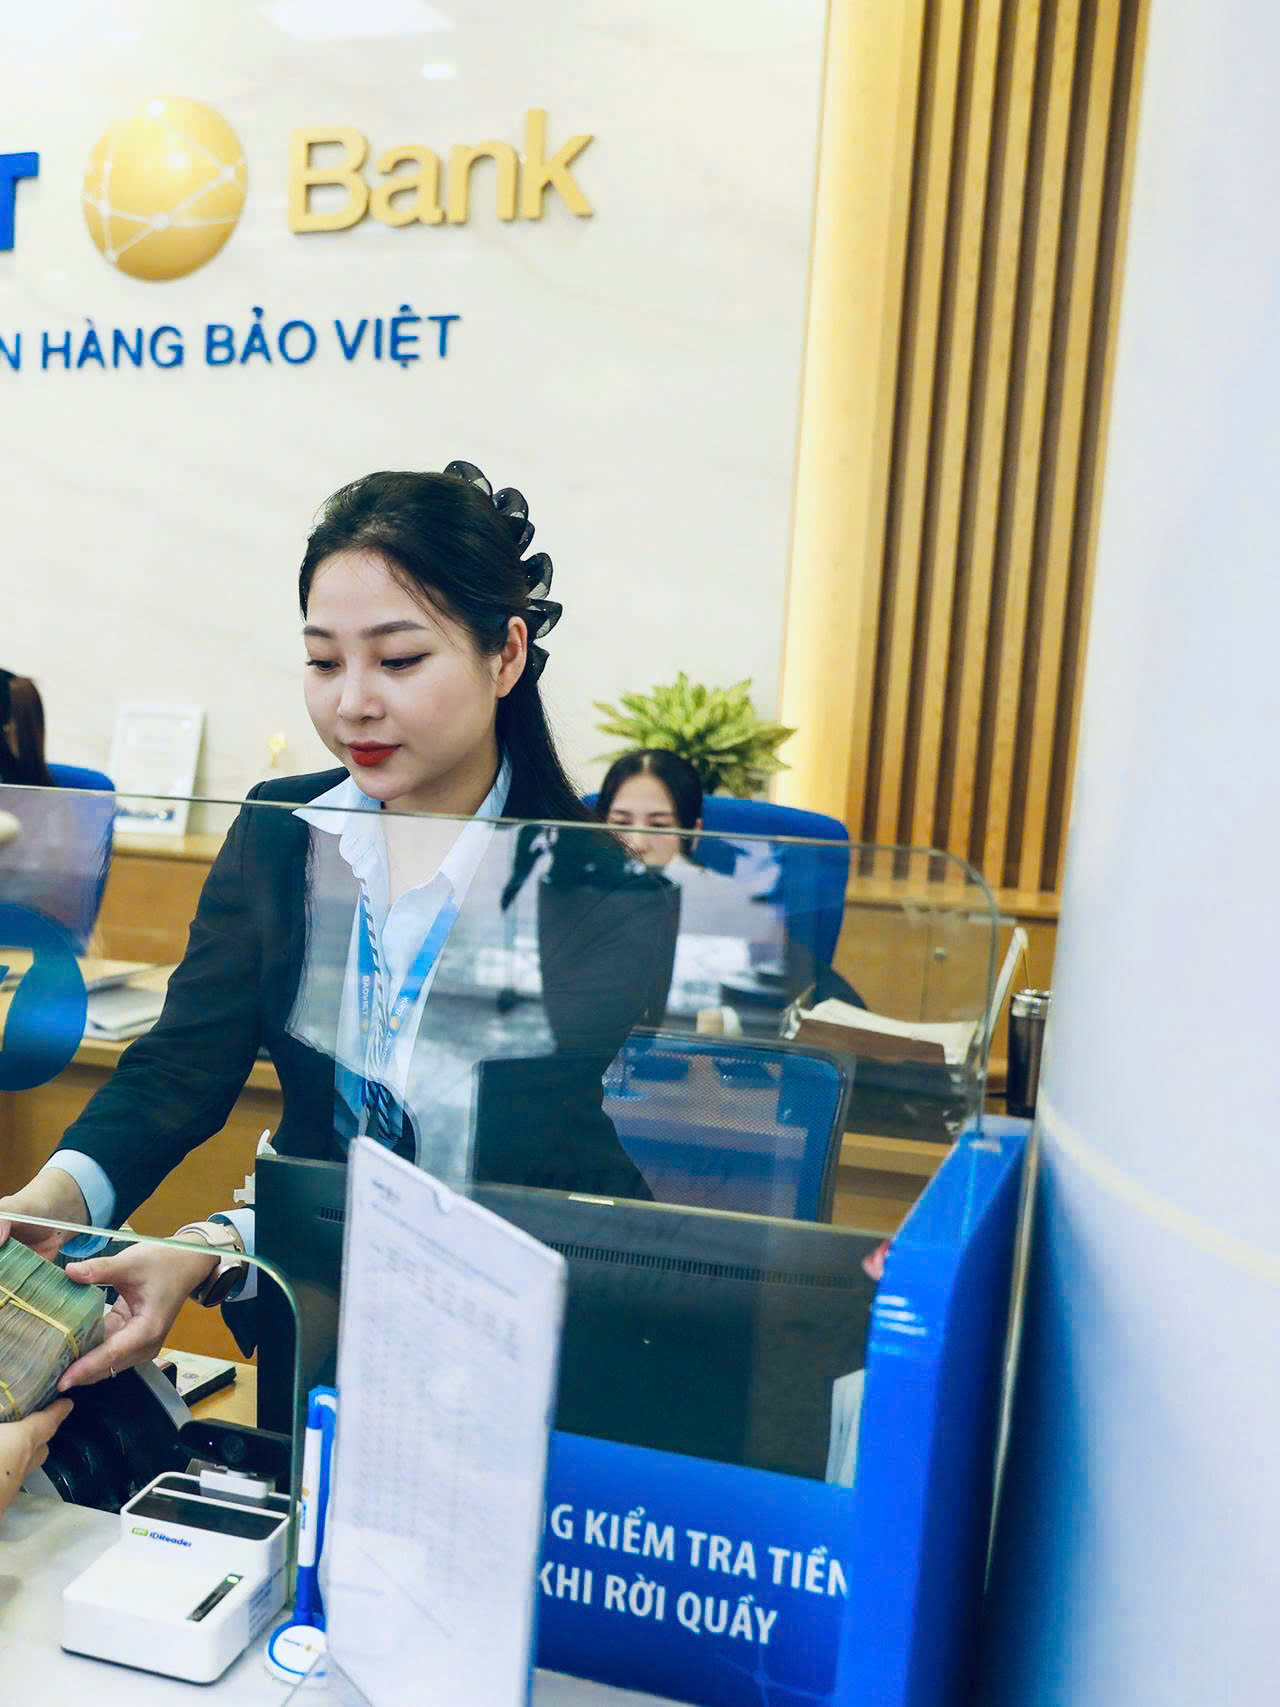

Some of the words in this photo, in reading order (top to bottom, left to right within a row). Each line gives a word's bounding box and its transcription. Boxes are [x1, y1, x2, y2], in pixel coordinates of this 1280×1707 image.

[288, 107, 595, 234] Bank
[41, 318, 185, 370] HÀNG
[205, 306, 317, 366] BẢO
[333, 304, 461, 368] VIỆT
[543, 1503, 573, 1540] G
[584, 1506, 675, 1562] KIỂM
[686, 1529, 757, 1580] TRA
[604, 1572, 666, 1621] RỜI
[676, 1594, 778, 1645] QUẦY
